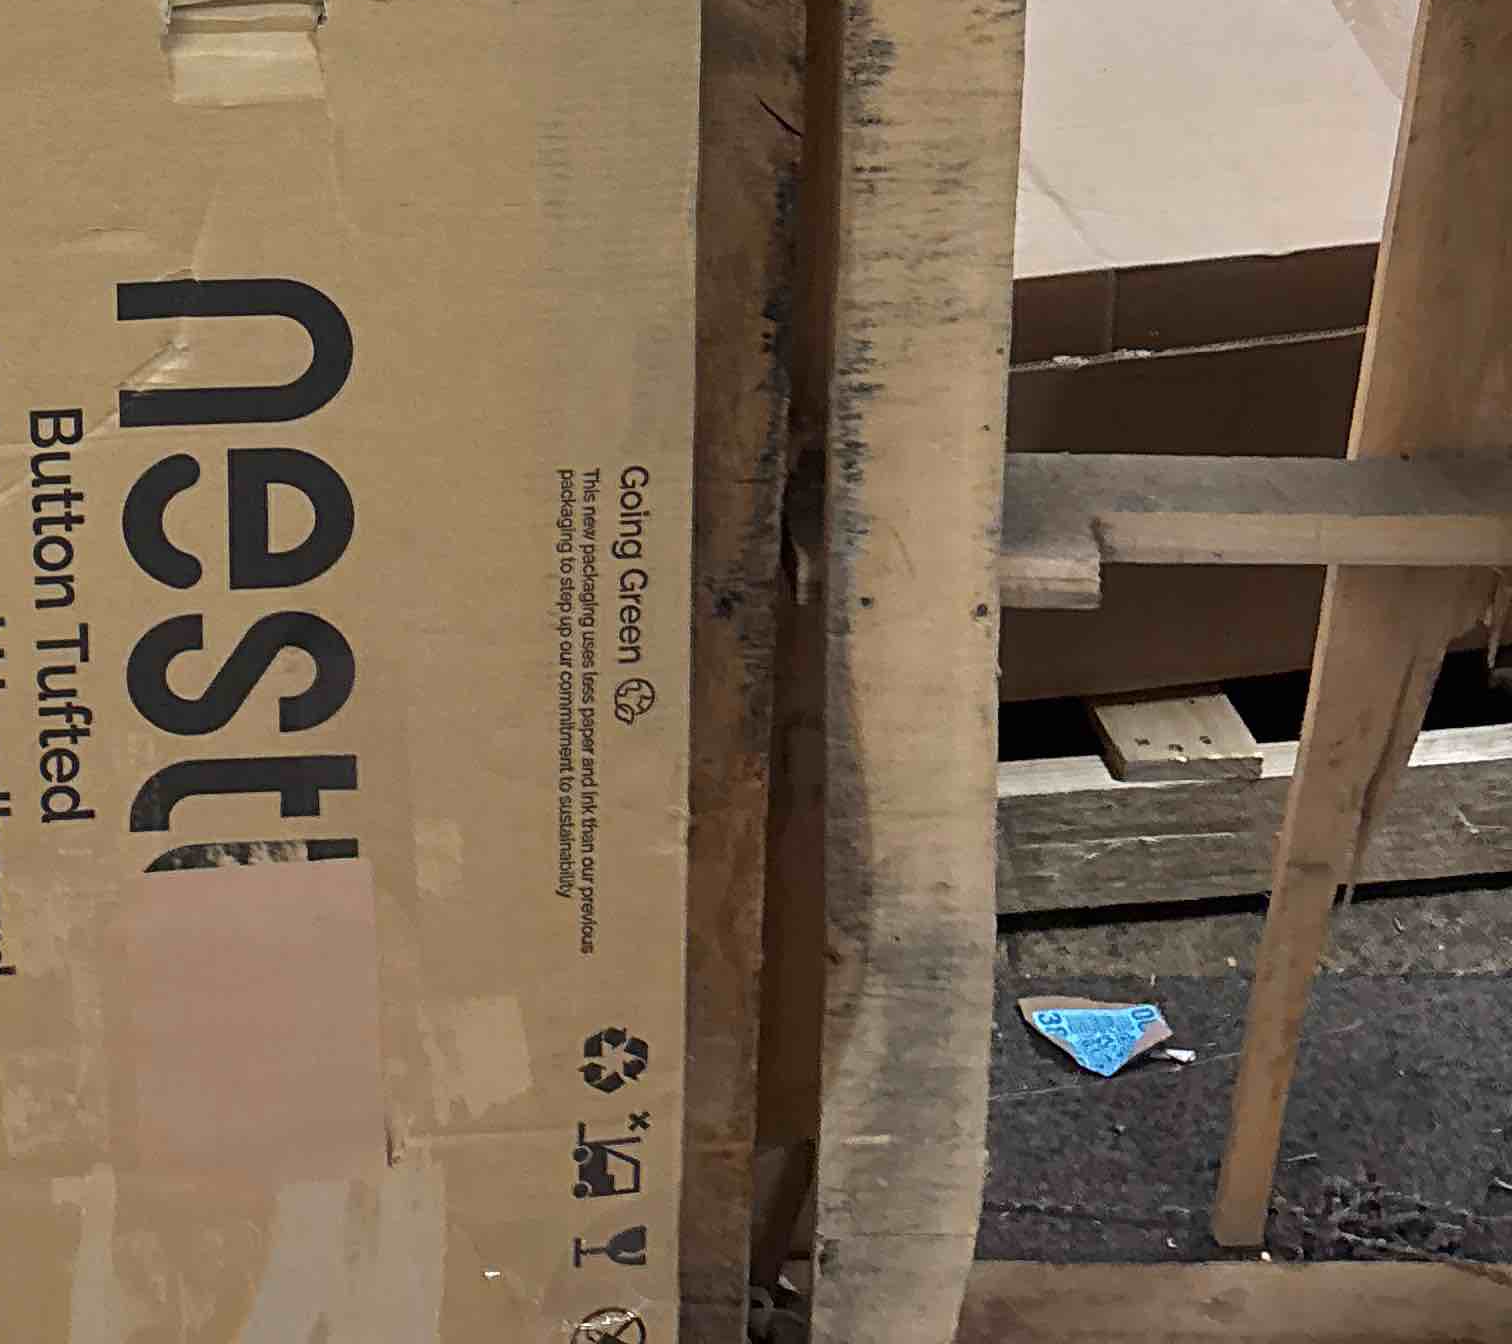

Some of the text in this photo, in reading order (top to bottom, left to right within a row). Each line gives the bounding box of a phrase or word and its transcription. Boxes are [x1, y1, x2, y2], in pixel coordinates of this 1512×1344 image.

[29, 407, 96, 824] Button Tufted
[554, 468, 577, 899] packaging to step up our commitment to sustainability
[577, 467, 601, 955] This new packaging uses less paper and ink than our previous
[611, 465, 651, 665] Going Green
